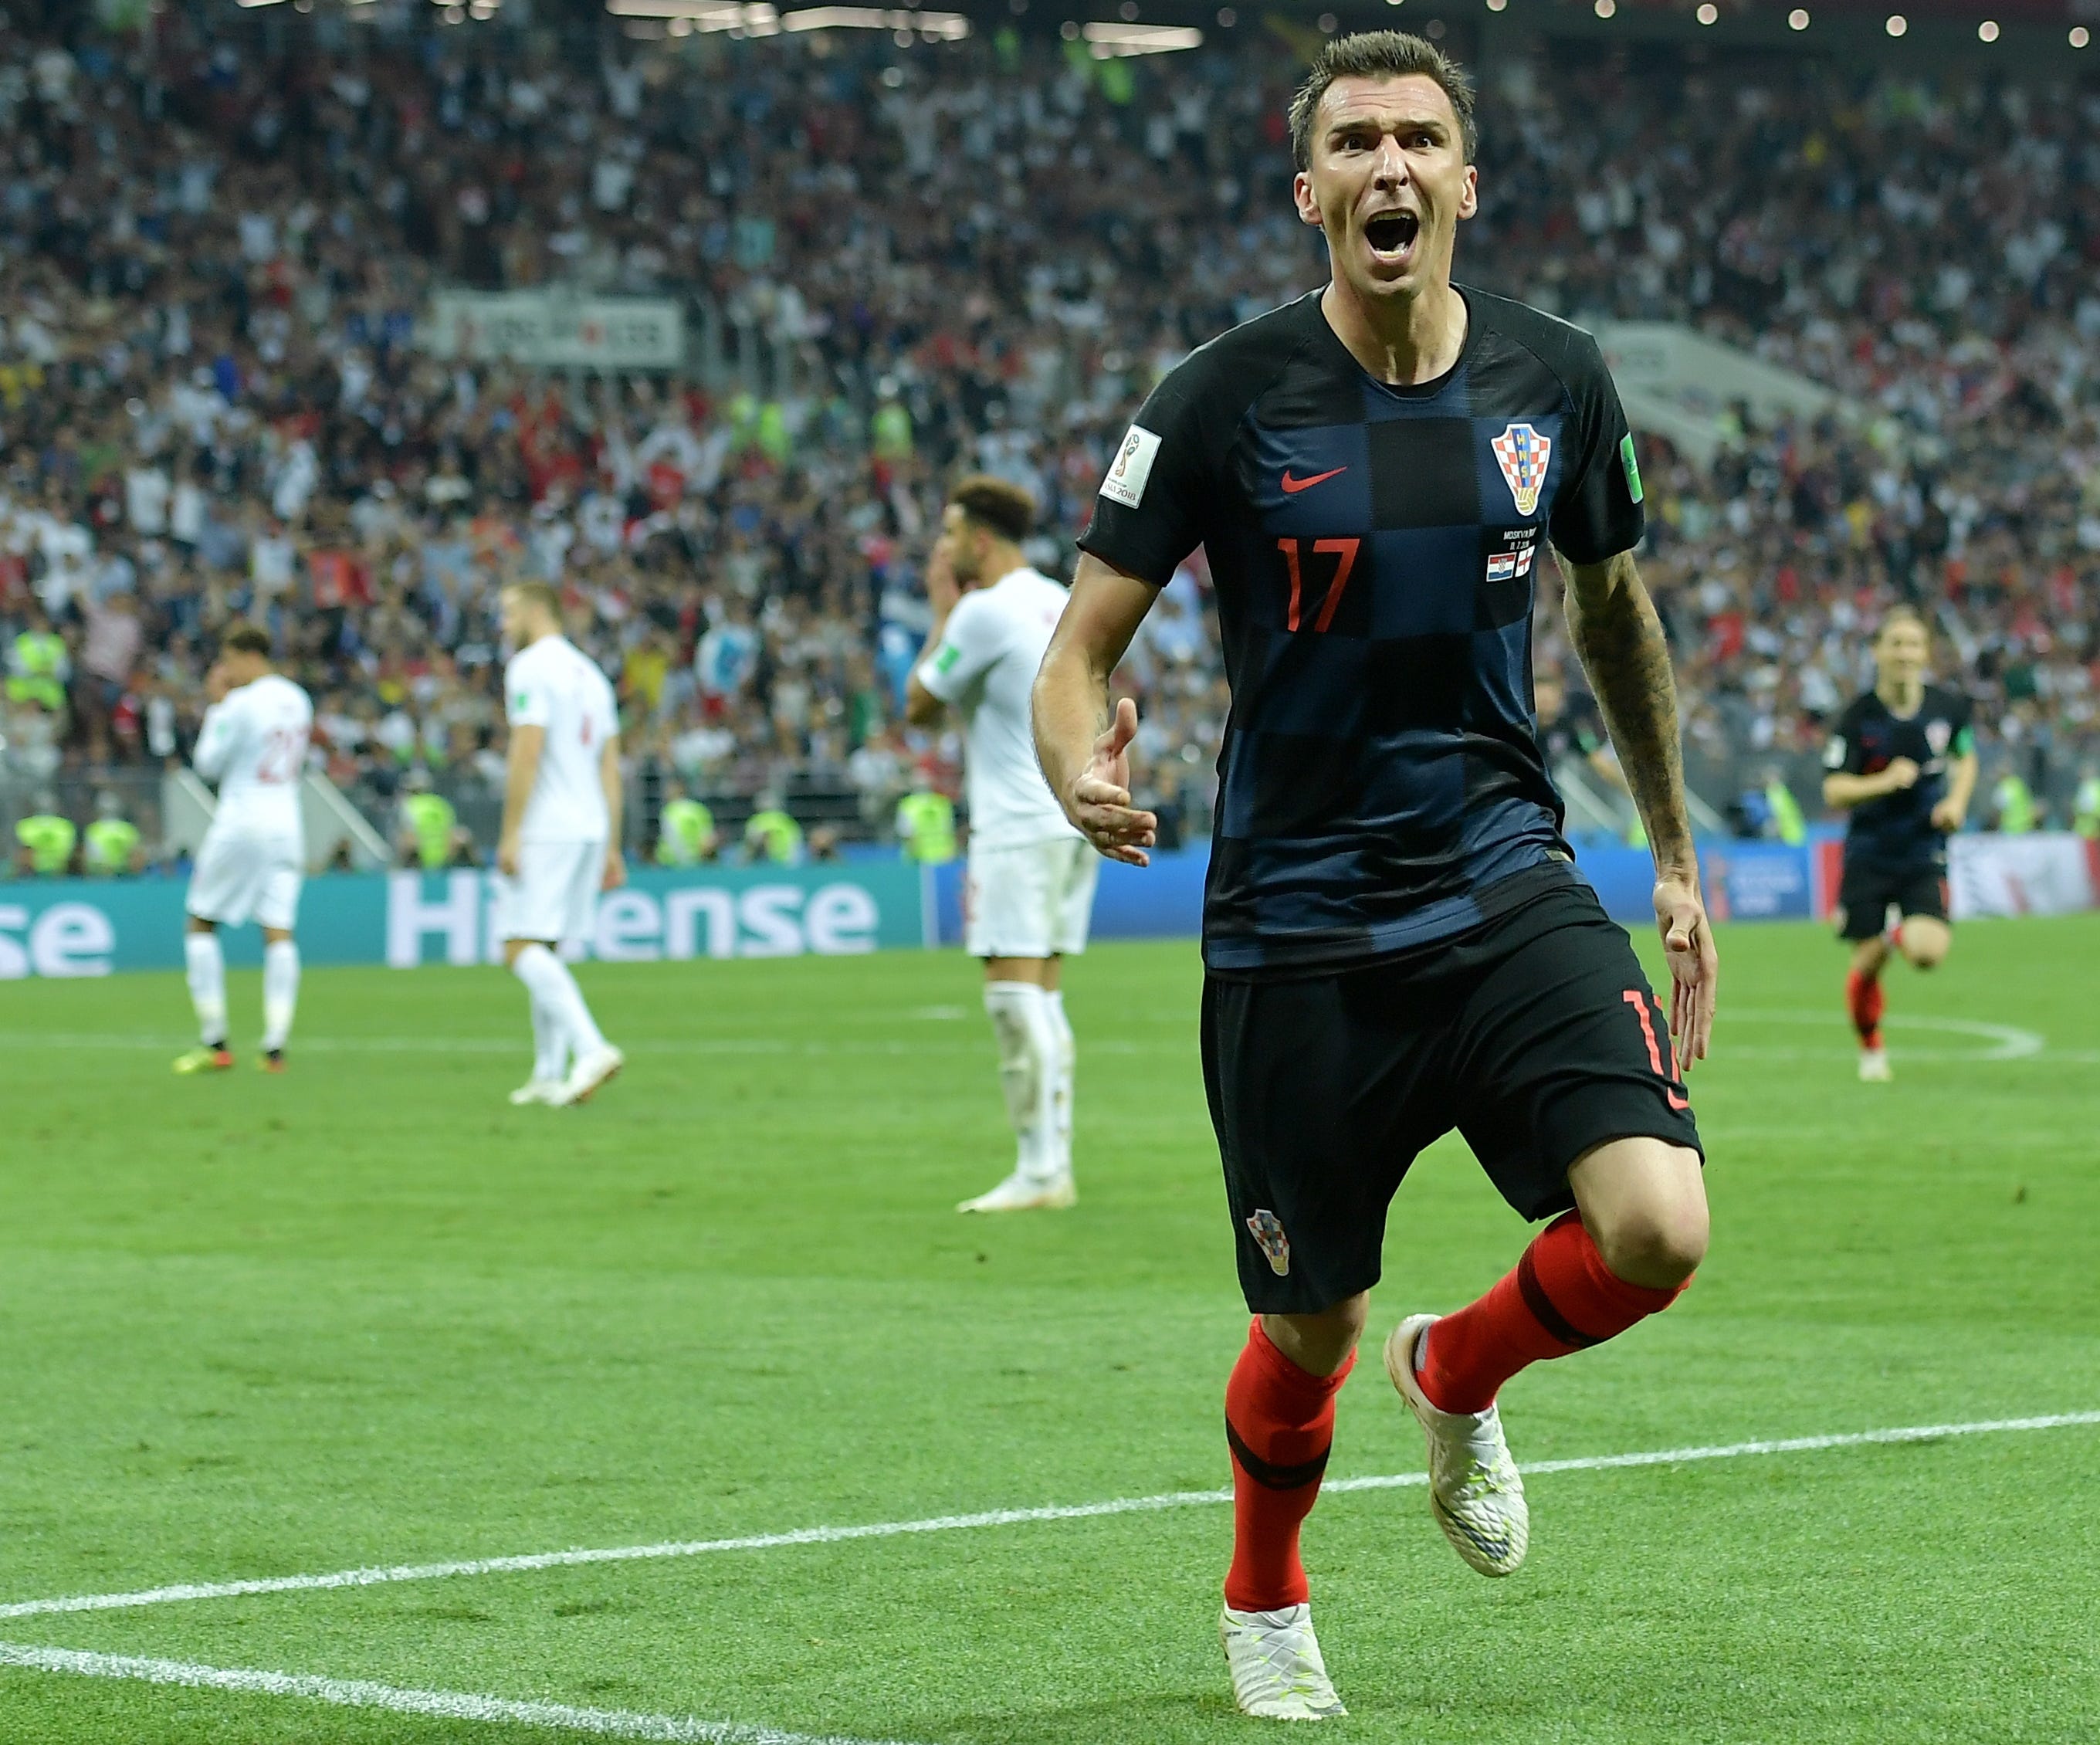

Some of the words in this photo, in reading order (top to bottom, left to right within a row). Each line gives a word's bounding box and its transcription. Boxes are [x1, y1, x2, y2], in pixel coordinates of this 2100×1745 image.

[1516, 435, 1528, 477] HNS
[1116, 488, 1136, 500] 2018
[1277, 538, 1360, 632] 17
[388, 866, 879, 968] Hiense
